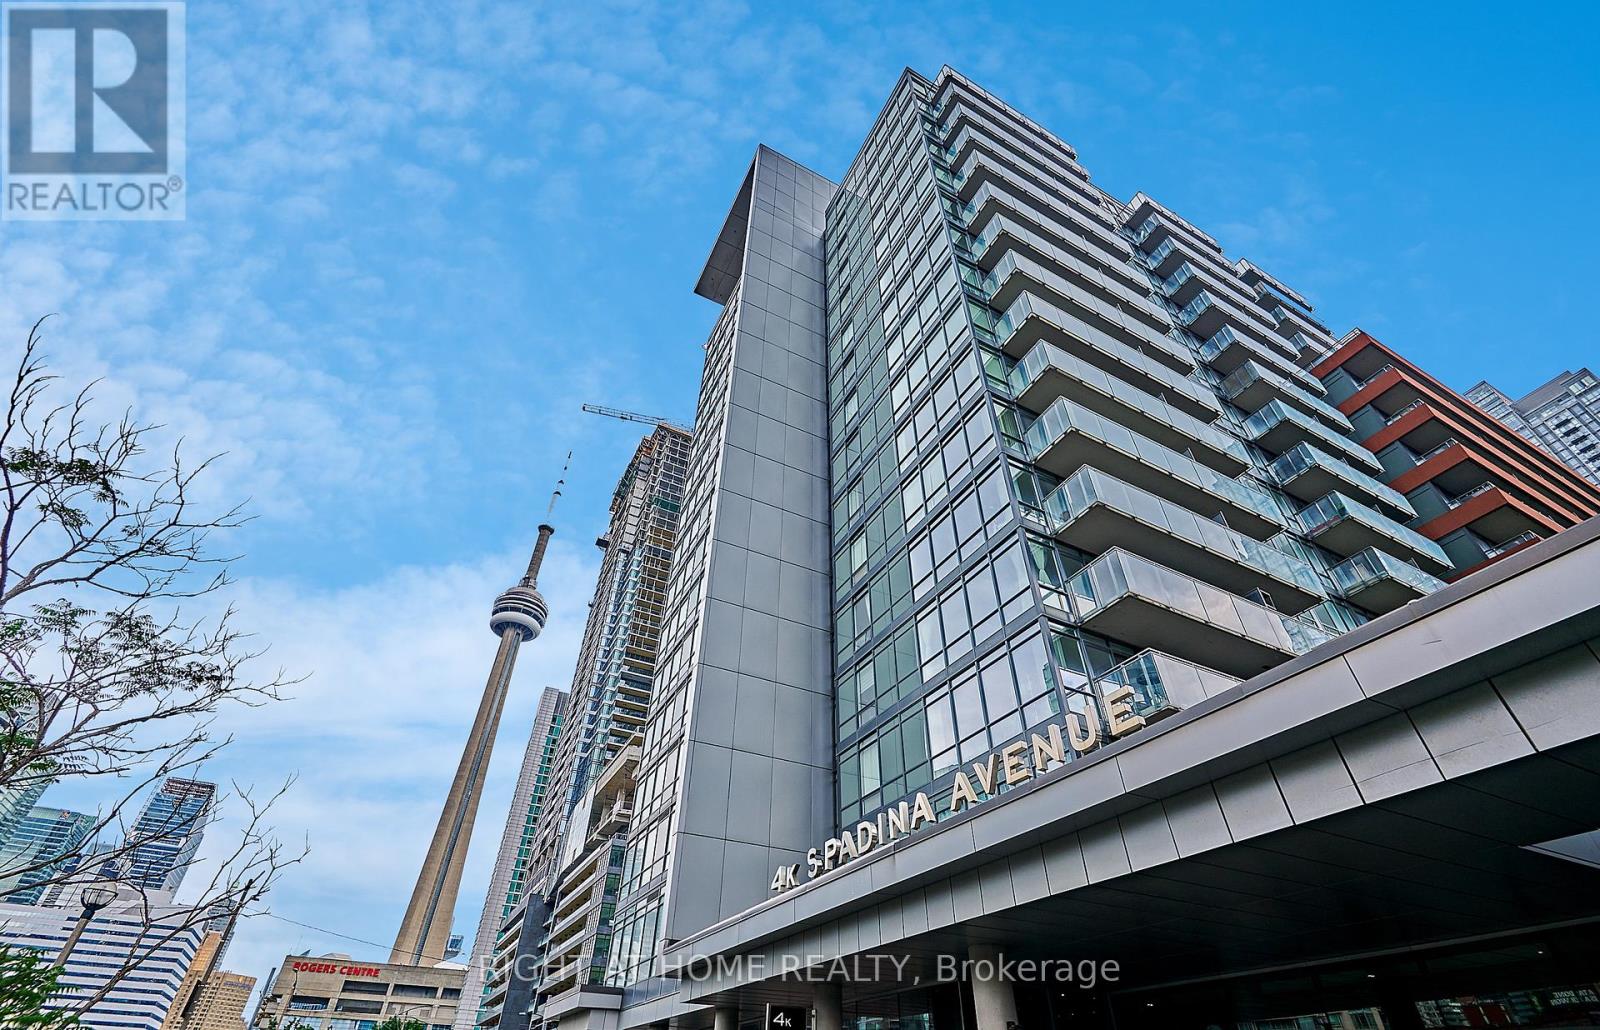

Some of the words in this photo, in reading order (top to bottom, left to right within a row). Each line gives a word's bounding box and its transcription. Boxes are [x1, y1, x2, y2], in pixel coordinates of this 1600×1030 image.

[770, 863, 801, 893] 4K
[806, 792, 936, 877] SPADINA
[950, 684, 1147, 812] AVENUE
[292, 961, 337, 974] ROGERS
[340, 965, 381, 978] CENTRE
